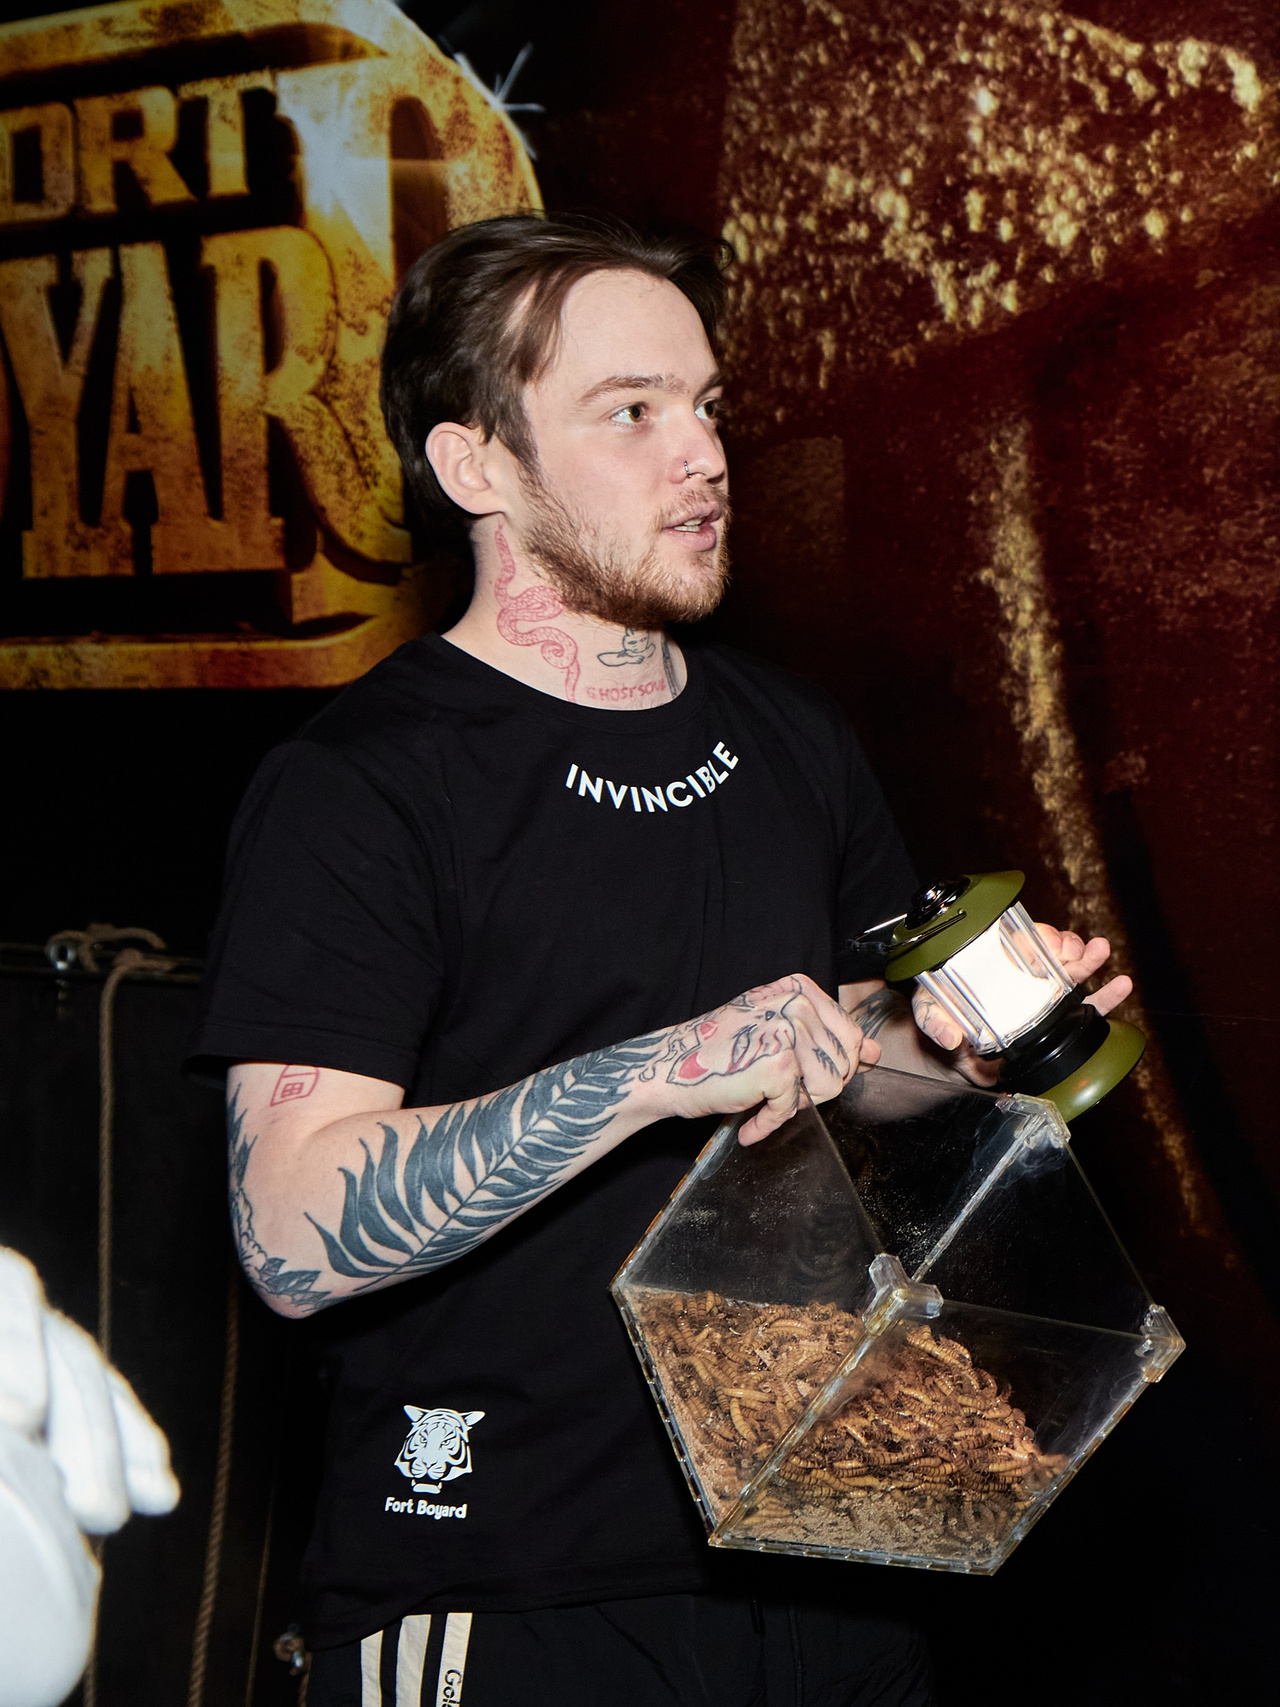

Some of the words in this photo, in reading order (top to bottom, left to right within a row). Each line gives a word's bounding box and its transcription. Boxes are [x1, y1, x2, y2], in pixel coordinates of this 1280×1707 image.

[565, 741, 739, 813] INVINCIBLE
[384, 1496, 414, 1514] Fort
[416, 1499, 468, 1520] Boyard
[442, 1669, 462, 1707] Gol
